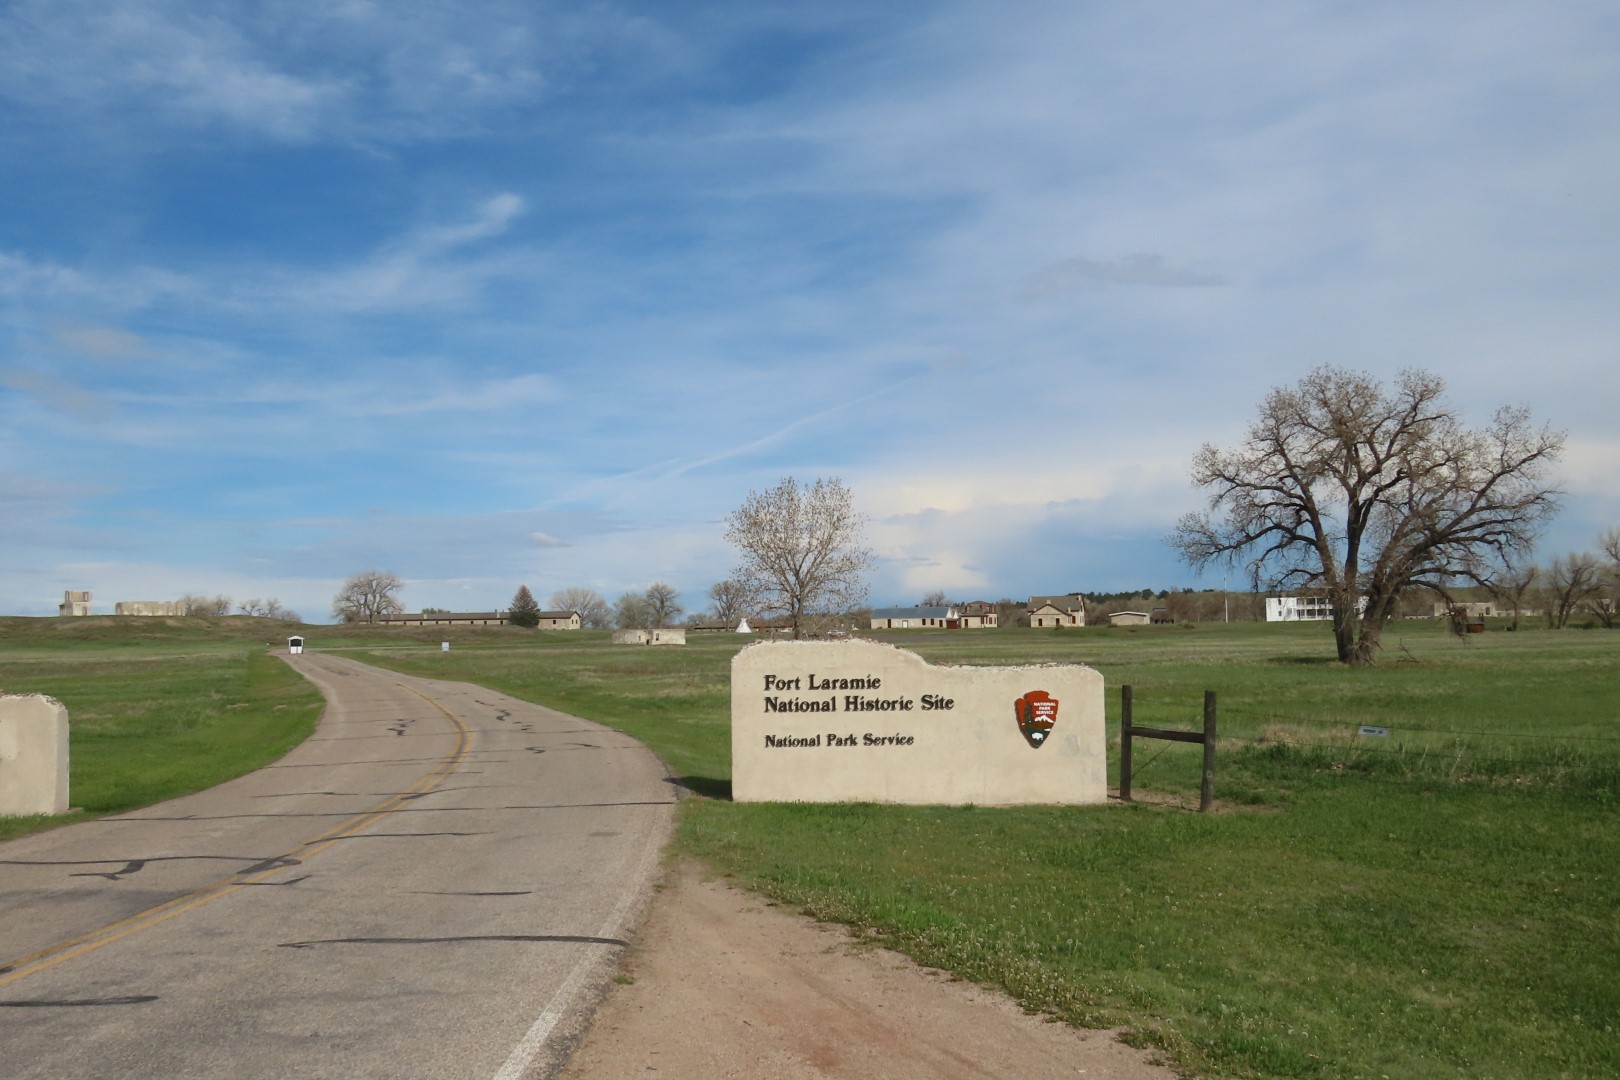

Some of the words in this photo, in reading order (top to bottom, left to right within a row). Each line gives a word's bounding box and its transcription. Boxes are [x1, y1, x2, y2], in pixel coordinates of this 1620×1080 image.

[764, 674, 800, 691] Fort
[808, 674, 881, 690] Laramie
[764, 696, 836, 712] National
[844, 695, 913, 711] Historic
[921, 694, 955, 710] Site
[765, 734, 820, 748] National
[826, 733, 858, 747] Park
[863, 732, 914, 746] Service
